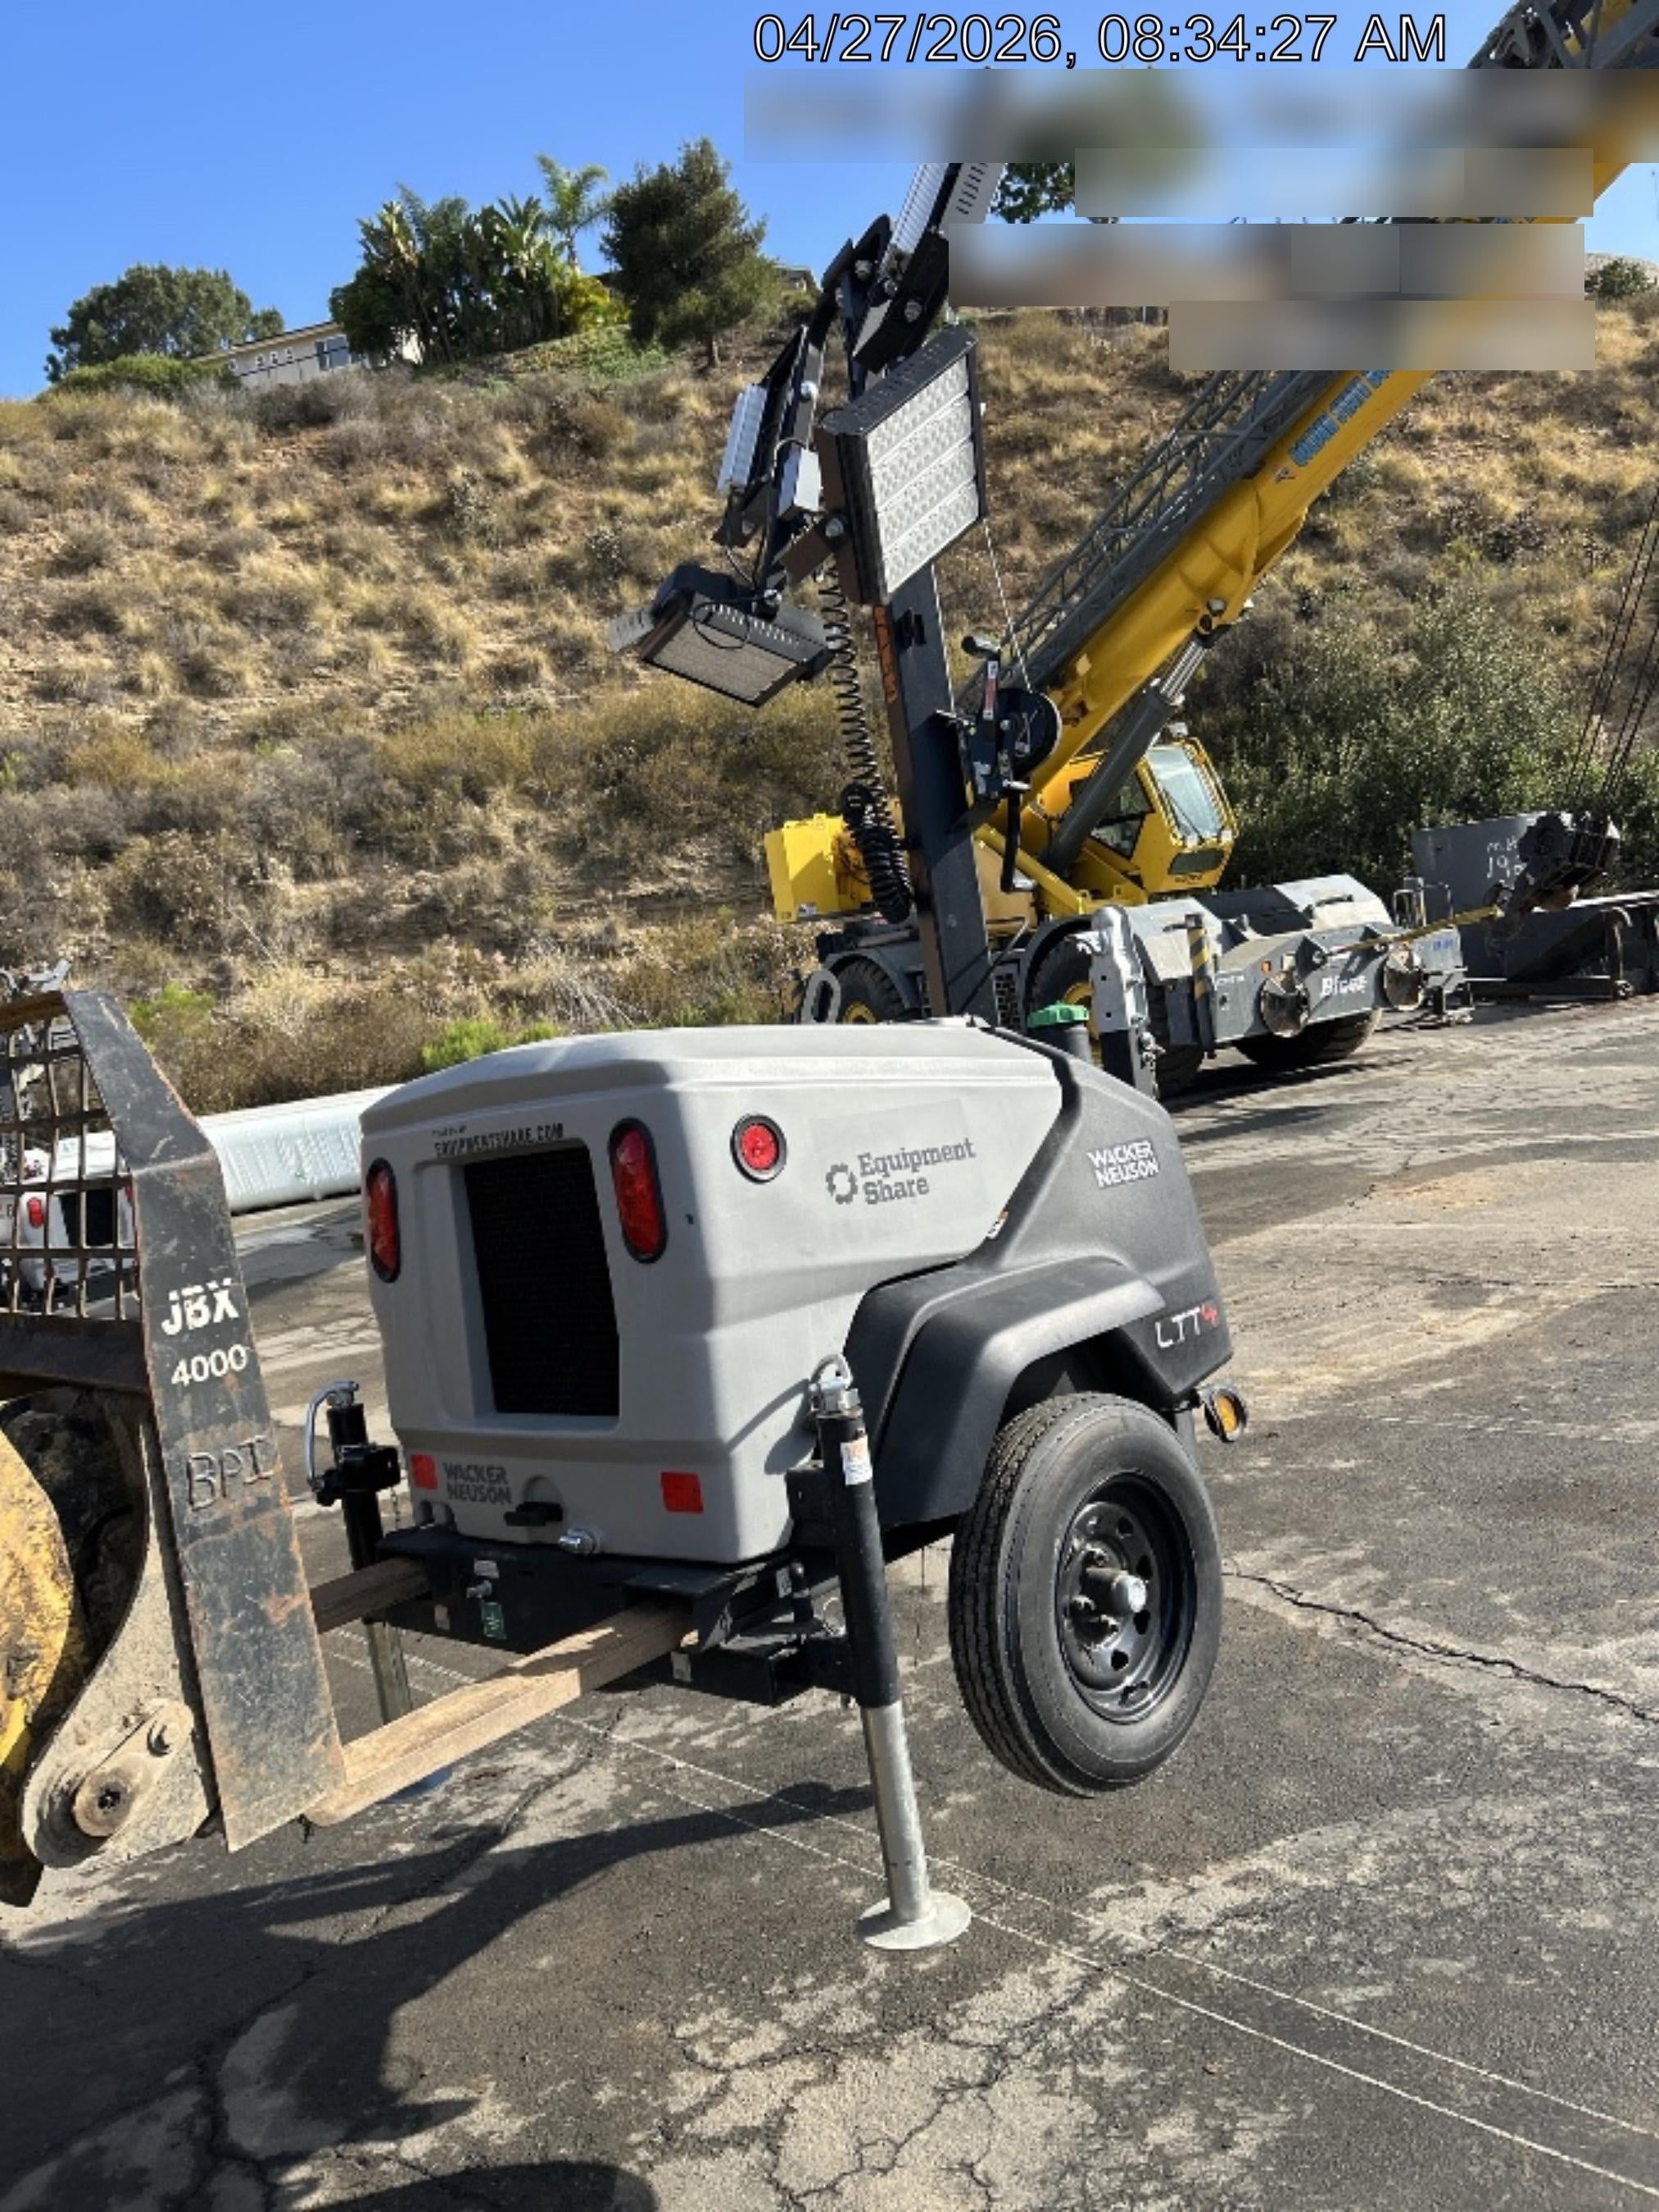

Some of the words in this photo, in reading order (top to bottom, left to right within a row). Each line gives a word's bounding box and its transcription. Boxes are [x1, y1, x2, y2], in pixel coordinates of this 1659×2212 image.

[858, 1137, 976, 1177] Equipment
[1086, 1140, 1154, 1168] WACKER
[1095, 1157, 1159, 1188] NEUSON
[863, 1176, 930, 1204] Share
[161, 1277, 239, 1335] JBX
[171, 1344, 247, 1386] 4000
[442, 1462, 509, 1485] WACKER
[447, 1484, 513, 1505] NEUSON
